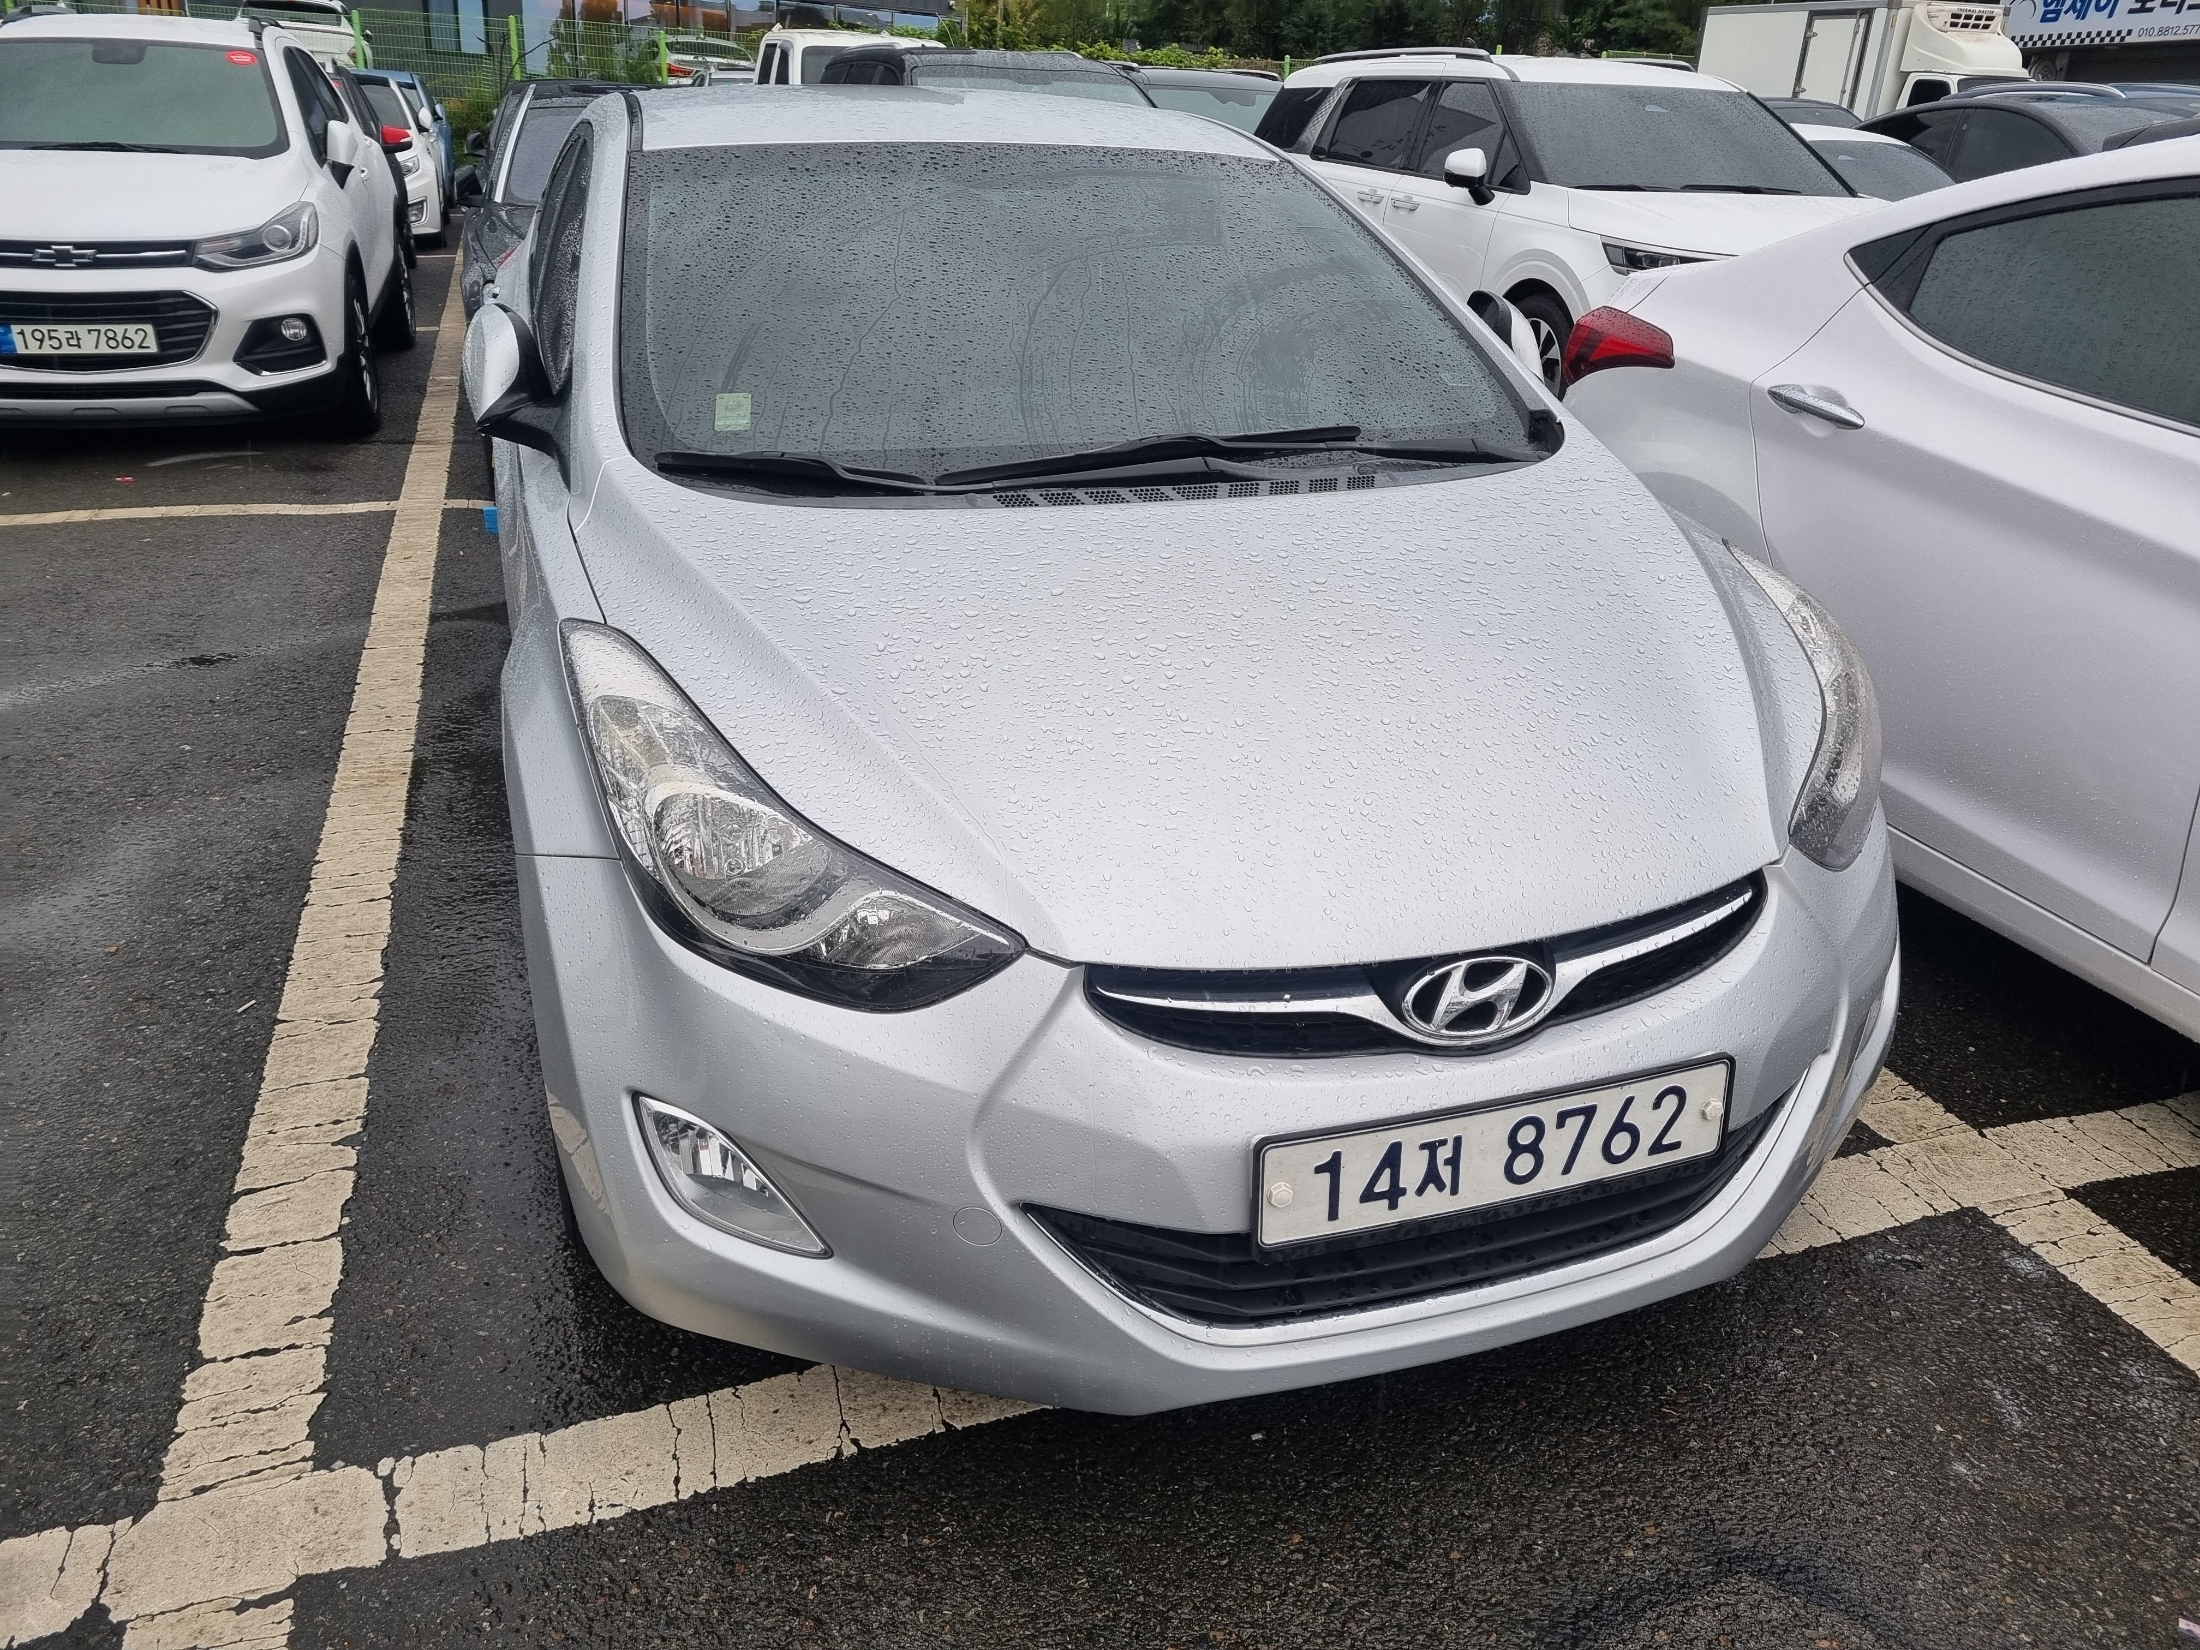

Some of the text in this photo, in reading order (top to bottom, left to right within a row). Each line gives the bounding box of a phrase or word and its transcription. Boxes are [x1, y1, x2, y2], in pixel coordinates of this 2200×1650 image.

[16, 327, 151, 350] 195라 7862
[1313, 1083, 1688, 1221] 14저 8762
